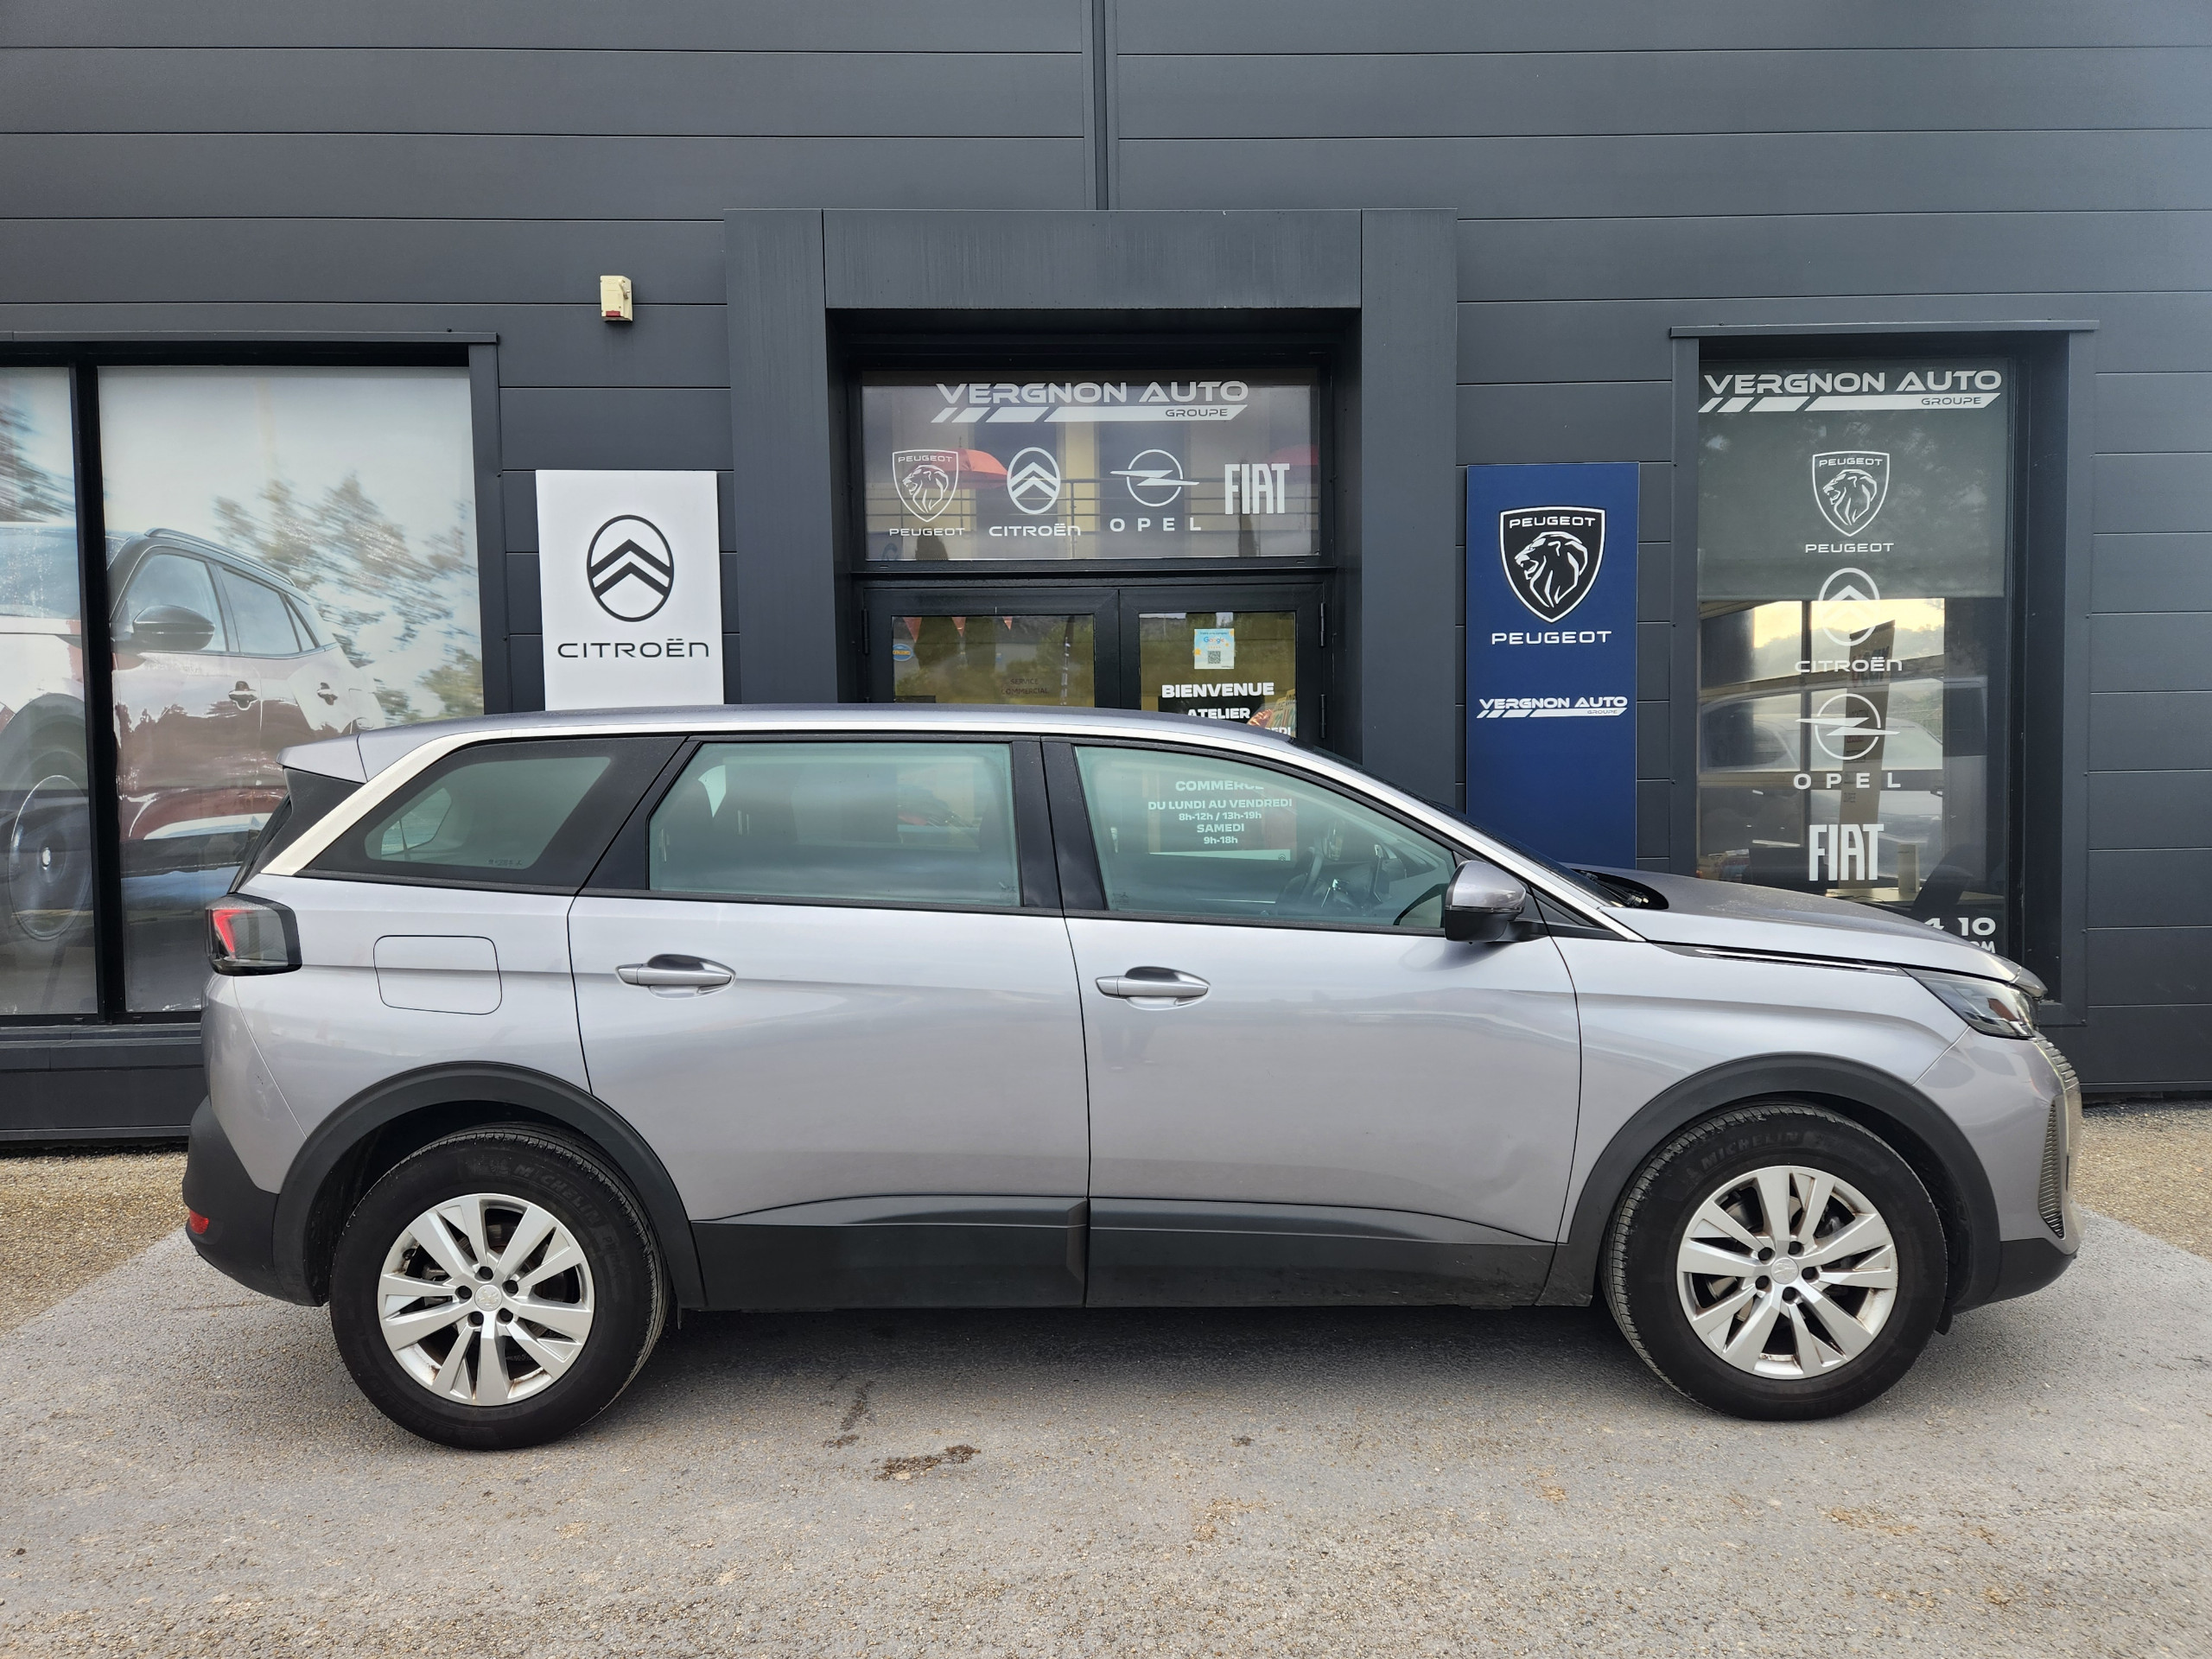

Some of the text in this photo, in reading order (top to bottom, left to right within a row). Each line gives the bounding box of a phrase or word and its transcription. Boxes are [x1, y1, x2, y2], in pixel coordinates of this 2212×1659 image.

[1703, 370, 2002, 394] VERGNON AUTO
[936, 381, 1249, 404] VERGNON AUTO
[1921, 397, 1982, 406] GROUPE
[1165, 407, 1229, 418] GROUPE
[897, 454, 953, 464] PEUGEOT
[1818, 457, 1883, 467] PEUGEOT
[1224, 463, 1290, 514] FIAT
[1109, 517, 1202, 532] OPEL
[1509, 515, 1596, 529] PEUGEOT
[889, 527, 965, 537] PEUGEOT
[988, 522, 1082, 537] CITROËN
[1804, 543, 1895, 554] PEUGEOT
[1203, 636, 1225, 645] Google
[1491, 630, 1613, 645] PEUGEOT
[557, 638, 709, 658] CITROËN
[1795, 657, 1904, 673] CITROËN
[1001, 687, 1048, 696] COMMERCIAL
[1161, 682, 1275, 698] BIENVENUE
[1479, 696, 1628, 710] VERGNON AUTO
[1187, 707, 1250, 720] ATELIER
[1794, 772, 1901, 790] OPEL
[1147, 798, 1293, 810] DU LUNDI AU VENDREDI
[1178, 812, 1213, 821] 8h-12h
[1222, 810, 1262, 820] 13h-19h
[1196, 823, 1245, 833] SAMEDI
[1203, 836, 1238, 844] 9h-18h
[1808, 823, 1884, 880] FIAT
[1957, 917, 1997, 937] 10
[1700, 1132, 1799, 1170] MICHELIN
[513, 1164, 603, 1228] MICHELIN
